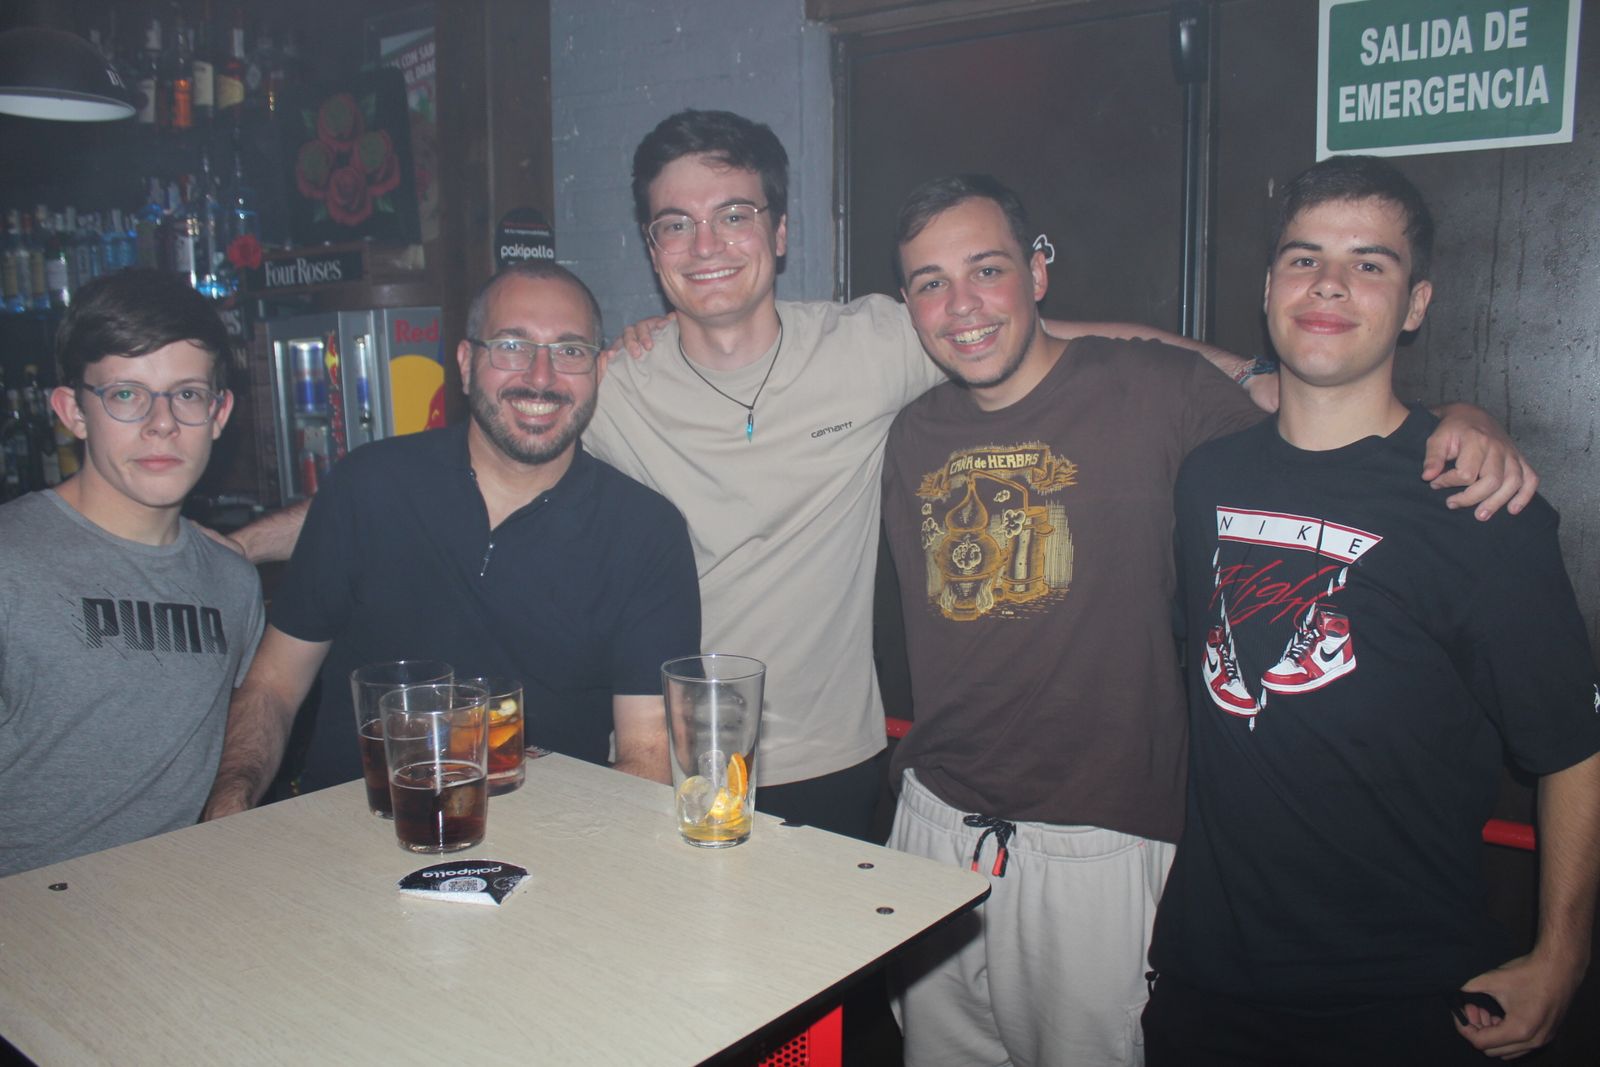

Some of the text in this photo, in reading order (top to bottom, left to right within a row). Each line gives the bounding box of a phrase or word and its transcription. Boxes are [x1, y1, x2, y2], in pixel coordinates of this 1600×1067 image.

[1359, 7, 1529, 66] SALIDA DE
[1339, 65, 1549, 123] EMERGENCIA
[500, 243, 555, 261] pakipalla
[395, 318, 439, 344] Red
[974, 457, 987, 469] de
[987, 453, 1040, 469] HERBAS
[1219, 516, 1363, 555] NIKE
[82, 597, 228, 655] PUMA
[422, 865, 502, 879] pakipalla
